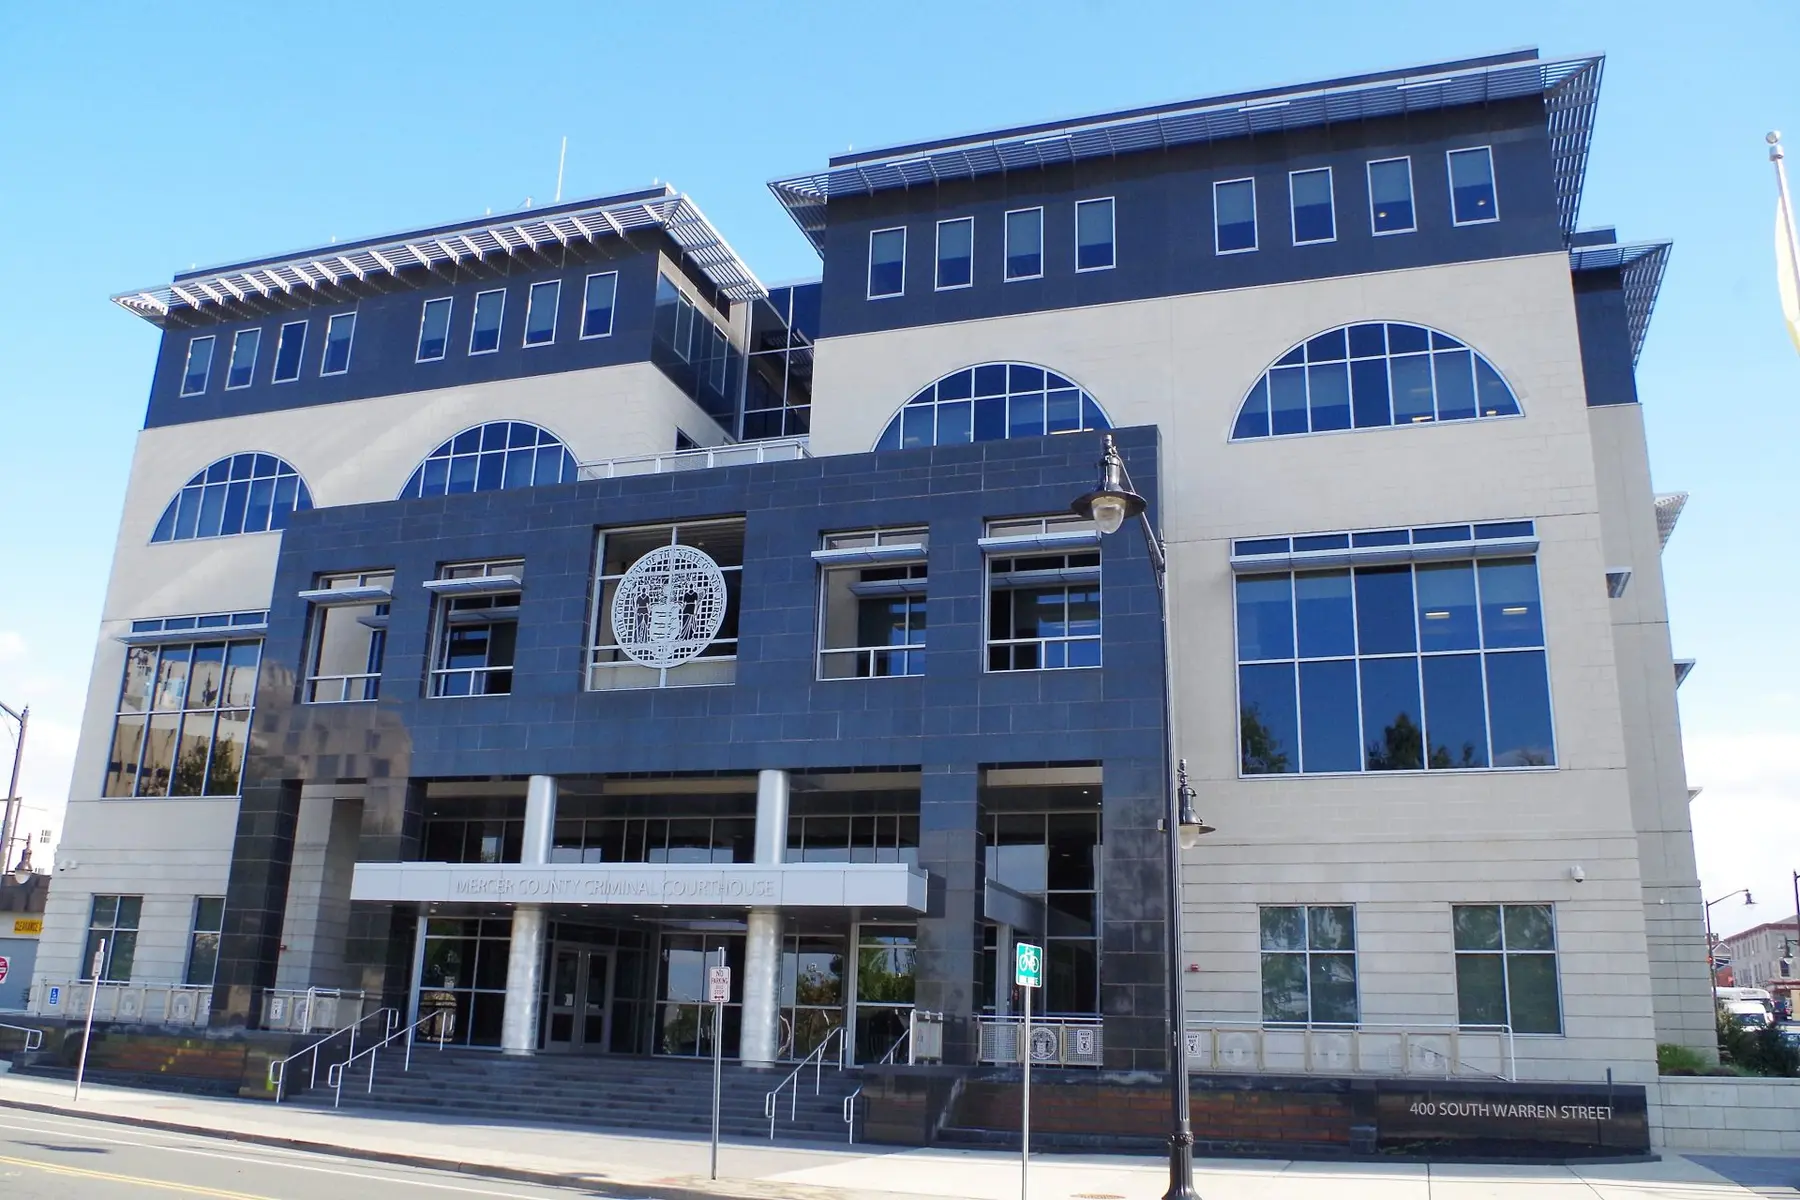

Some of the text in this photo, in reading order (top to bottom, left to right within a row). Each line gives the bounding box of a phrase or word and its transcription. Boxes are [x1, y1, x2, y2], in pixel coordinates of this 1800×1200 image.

[678, 551, 704, 565] STATE
[456, 879, 775, 897] MERCER COUNTY CRIMINAL COURTHOUSE
[1410, 1102, 1612, 1120] 400 SOUTH WARREN STREET
